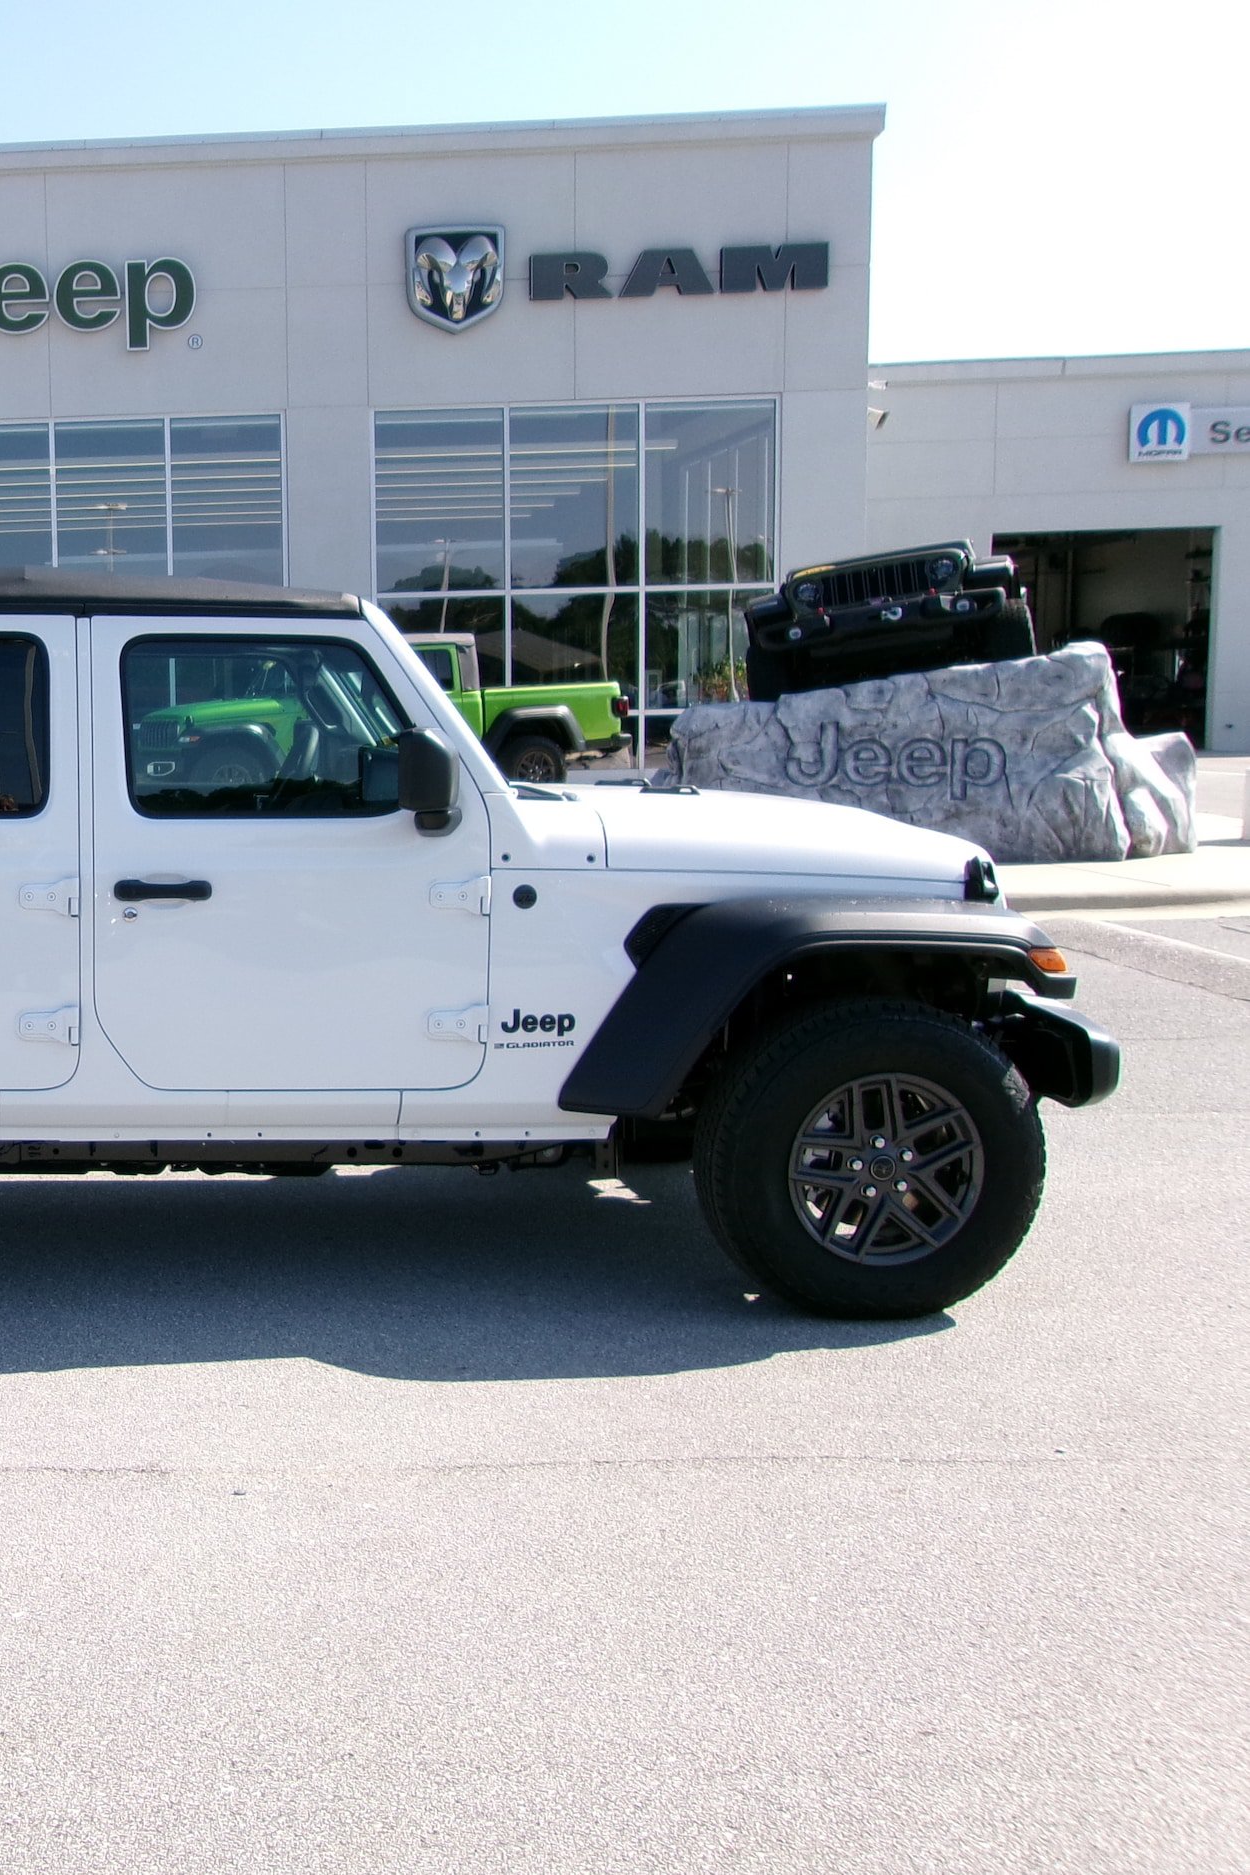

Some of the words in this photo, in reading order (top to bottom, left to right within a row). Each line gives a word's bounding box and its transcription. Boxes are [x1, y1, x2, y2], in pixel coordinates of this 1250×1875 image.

[529, 241, 829, 301] RAM
[784, 721, 1007, 800] Jeep
[501, 1008, 576, 1037] Jeep
[506, 1040, 575, 1049] GLADIATOR
